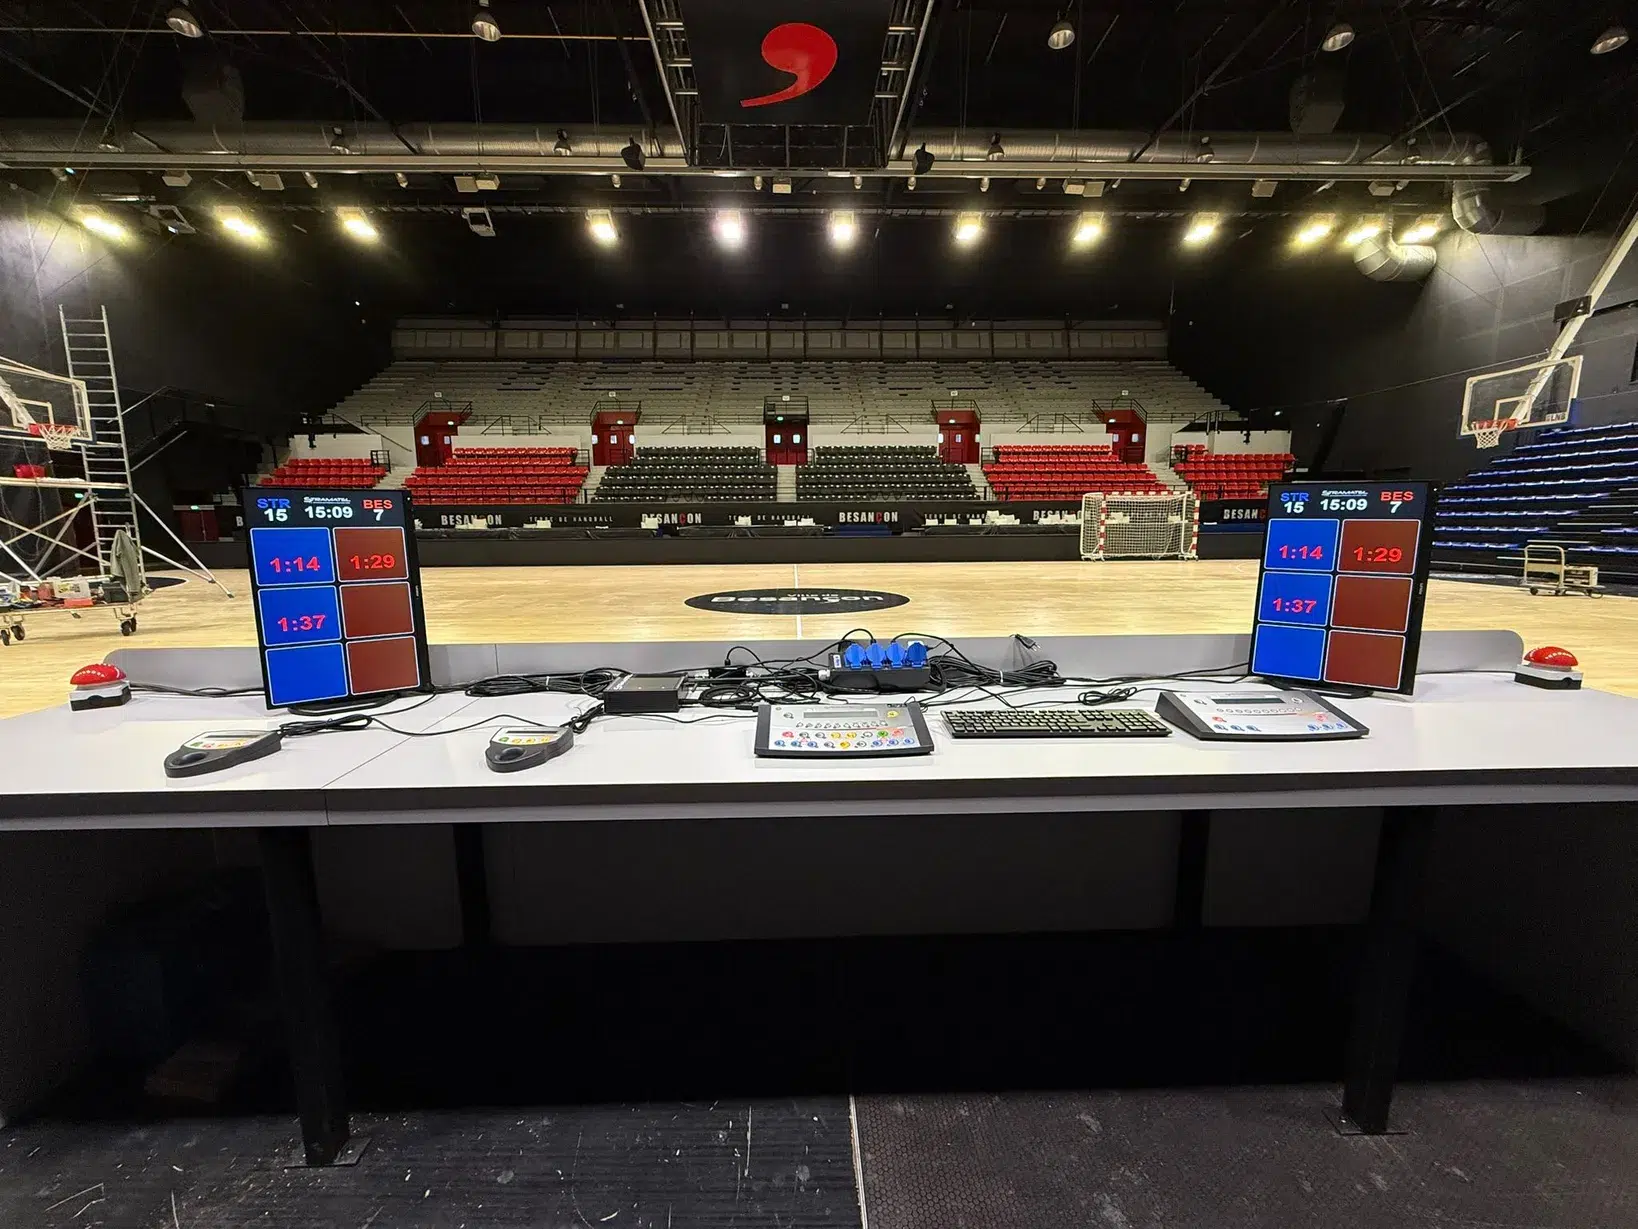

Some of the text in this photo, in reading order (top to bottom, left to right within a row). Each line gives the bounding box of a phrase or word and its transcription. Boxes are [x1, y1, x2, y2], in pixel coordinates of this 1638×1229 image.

[1280, 492, 1310, 502] STR
[1380, 491, 1414, 501] BES
[257, 498, 291, 509] STR
[362, 499, 393, 509] BES
[1283, 501, 1305, 513] 15
[1320, 498, 1368, 511] 15:09
[1389, 501, 1403, 513] 7
[263, 508, 289, 522] 15
[304, 506, 353, 519] 15:09
[373, 509, 385, 521] 7
[838, 511, 899, 524] BESANÇON
[1278, 545, 1323, 560] 1:14
[1353, 546, 1403, 563] 1:29
[269, 556, 321, 573] 1:14
[350, 554, 396, 570] 1:29
[1272, 597, 1317, 614] 1:37
[277, 614, 326, 632] 1:37
